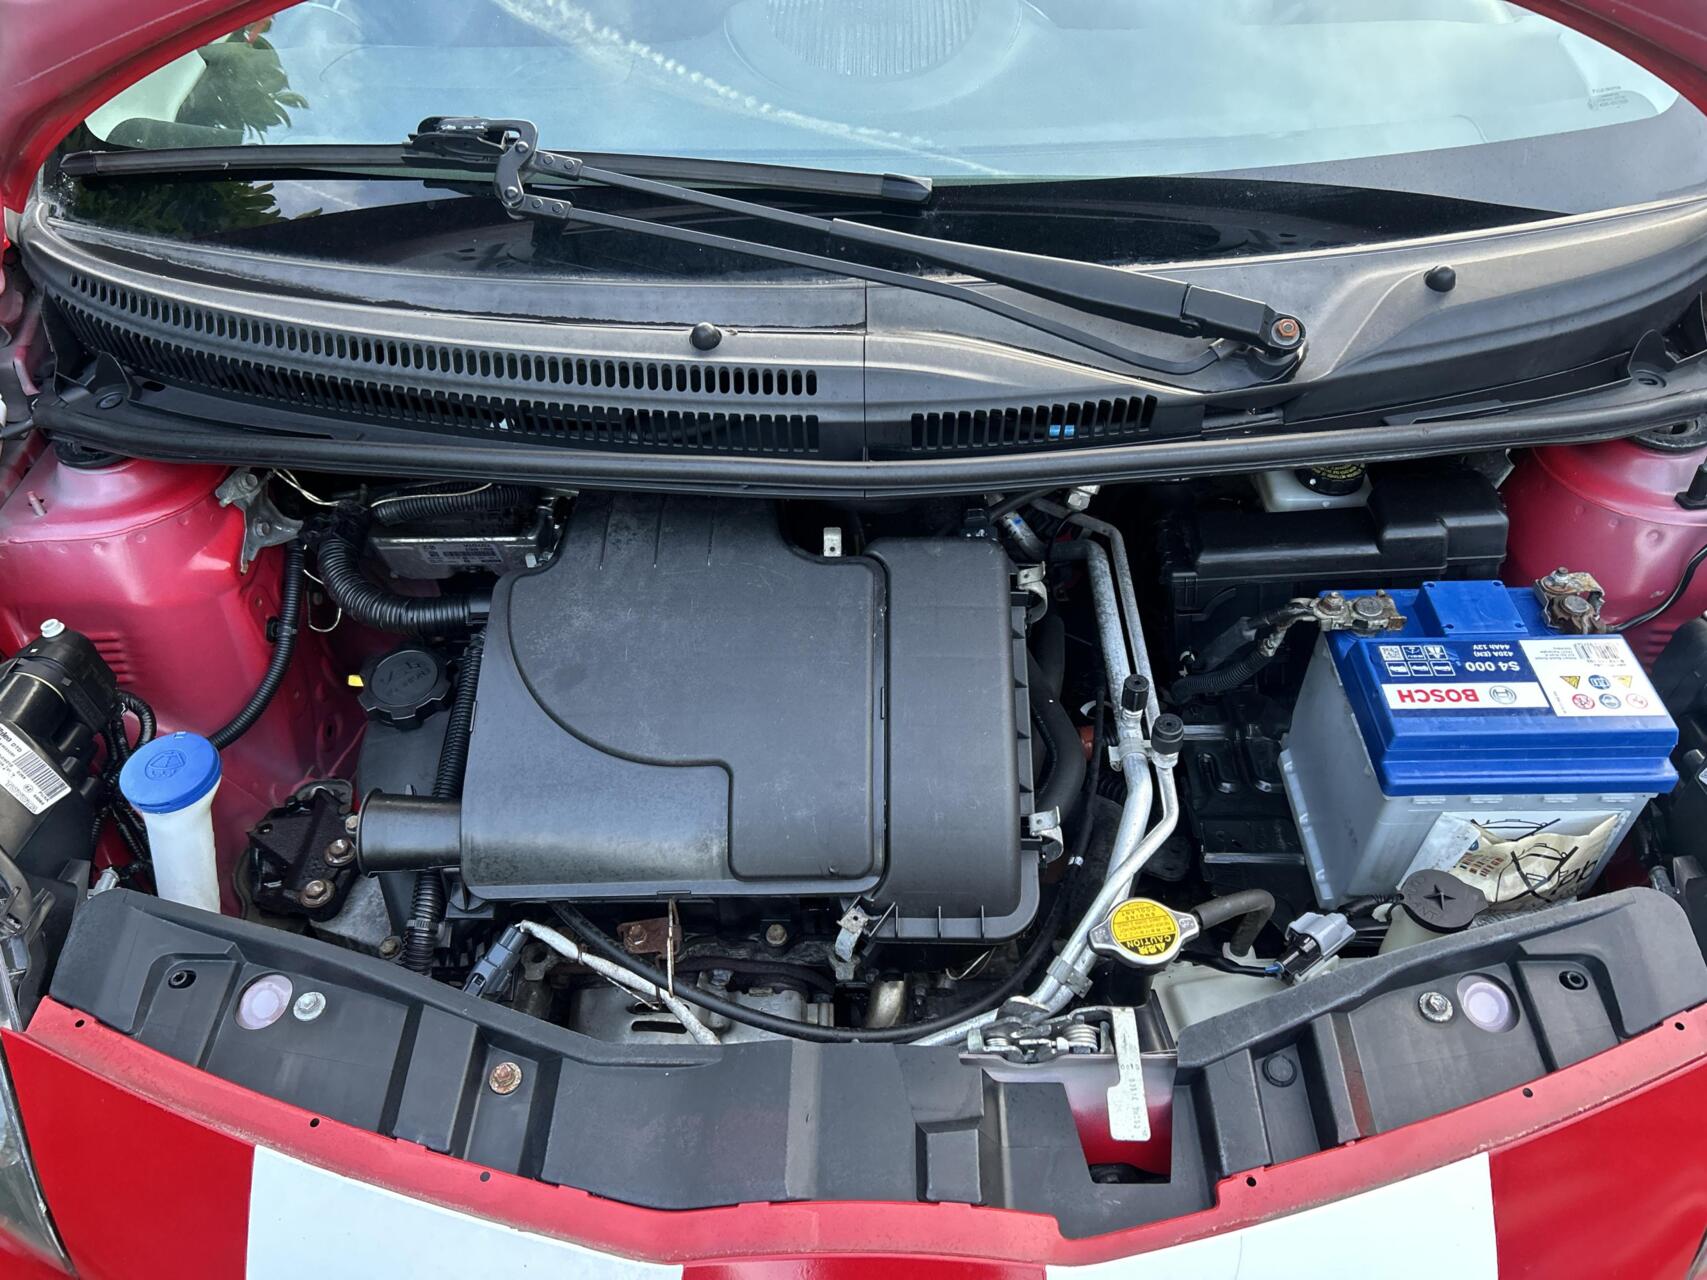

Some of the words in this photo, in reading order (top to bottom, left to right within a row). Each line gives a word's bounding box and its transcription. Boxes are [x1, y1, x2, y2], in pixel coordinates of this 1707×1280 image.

[1465, 661, 1496, 672] 000
[1498, 661, 1520, 671] S4
[1397, 688, 1480, 703] BOSCH
[1126, 934, 1171, 948] CAUTION
